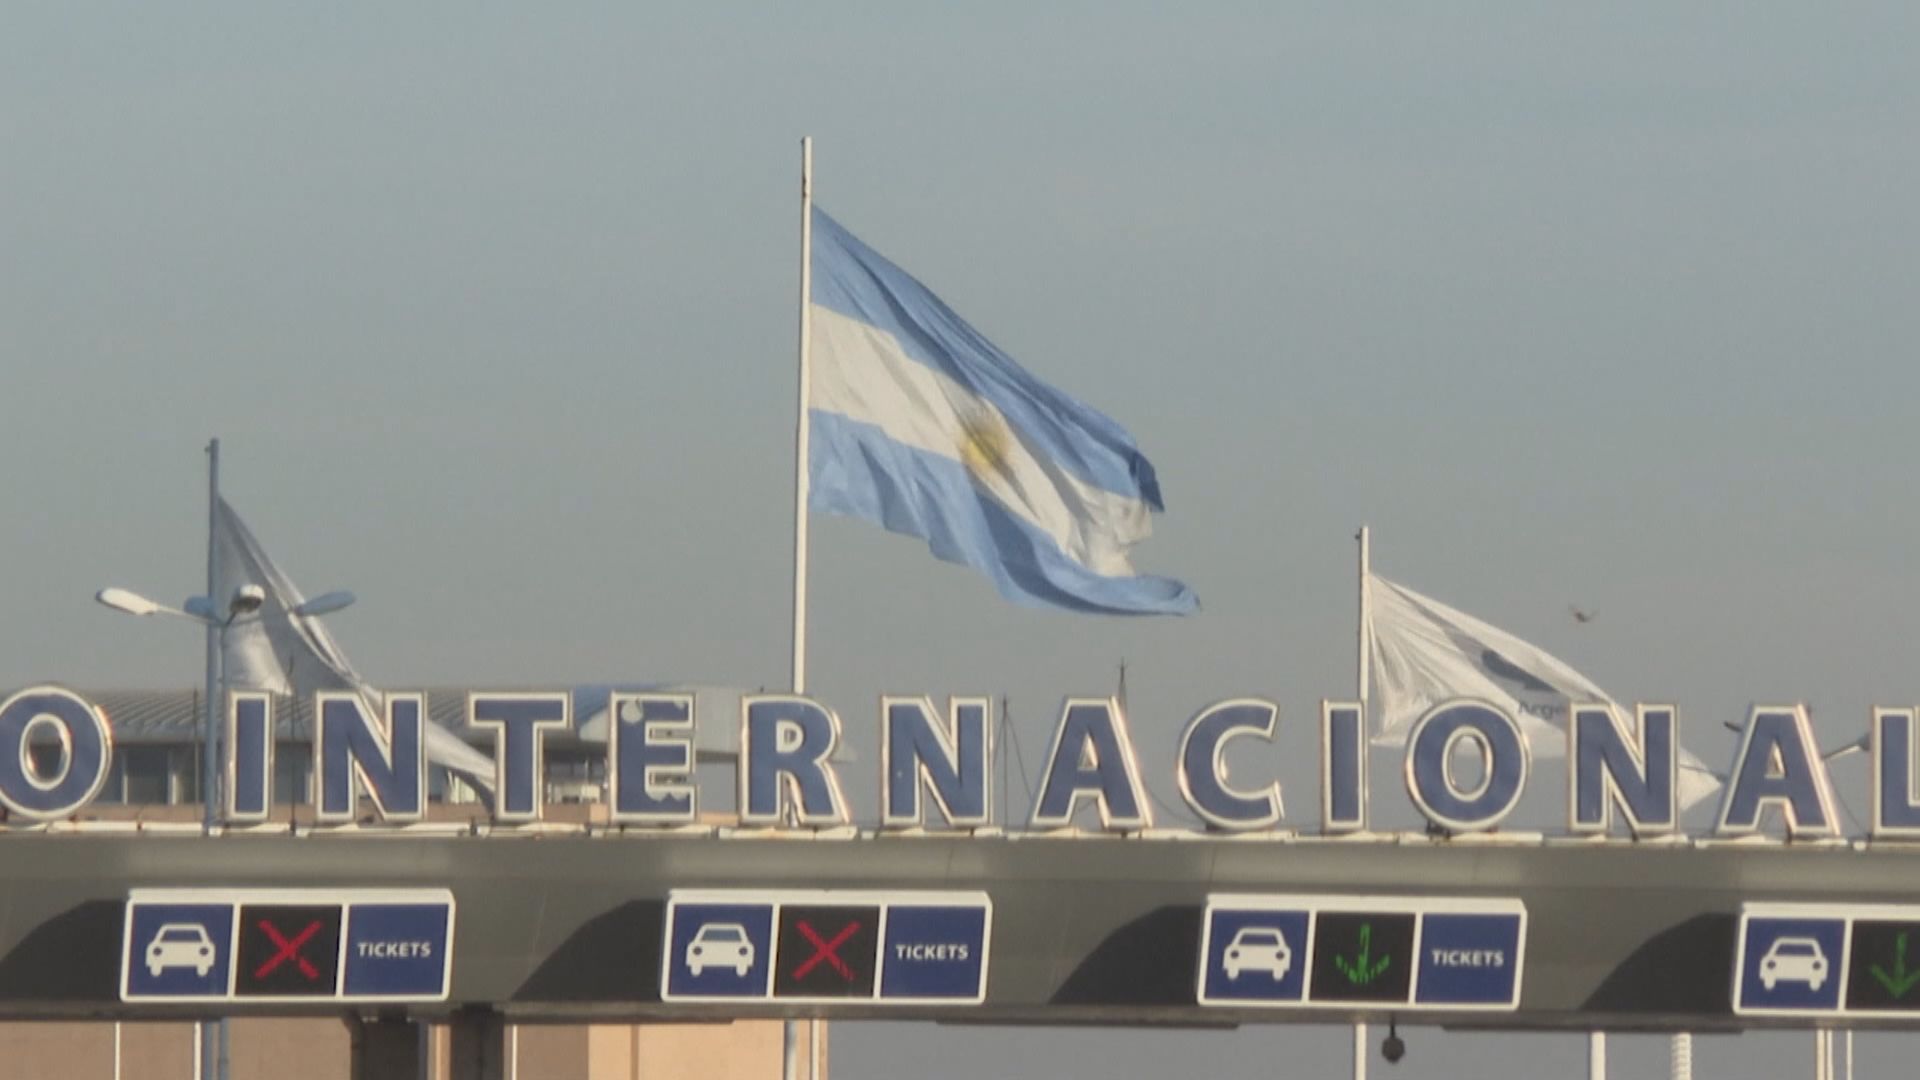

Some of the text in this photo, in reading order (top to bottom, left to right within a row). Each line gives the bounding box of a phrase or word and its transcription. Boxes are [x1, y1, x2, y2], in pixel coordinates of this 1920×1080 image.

[1518, 701, 1567, 720] Arge
[0, 685, 1920, 837] O INTERNACIONAL
[357, 942, 431, 957] TICKETS
[896, 943, 968, 960] TICKETS
[1432, 950, 1504, 967] TICKETS
